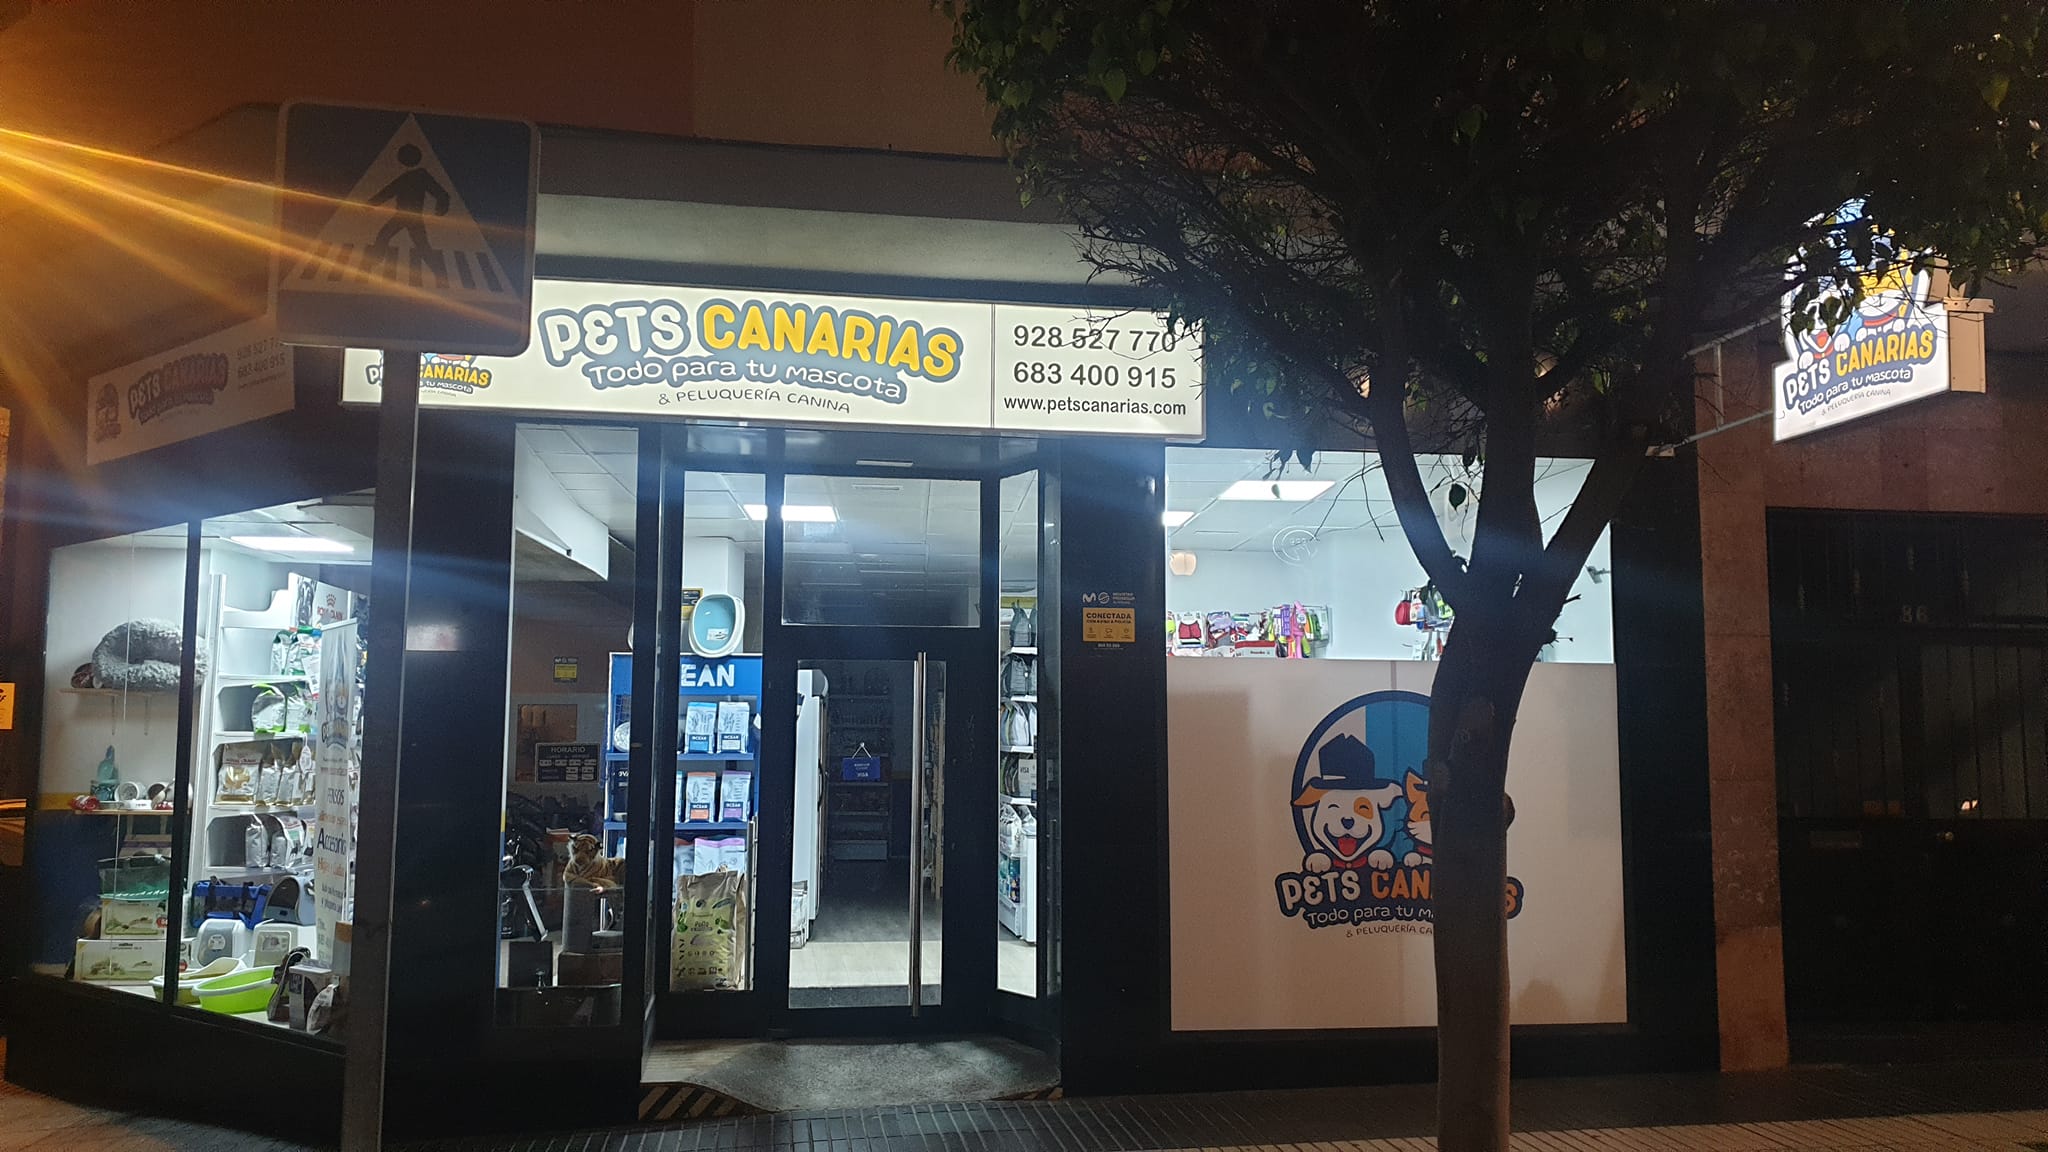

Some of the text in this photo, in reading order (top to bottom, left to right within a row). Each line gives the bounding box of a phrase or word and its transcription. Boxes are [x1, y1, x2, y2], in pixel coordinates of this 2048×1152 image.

[543, 303, 959, 378] PETS CANARIAS
[1013, 324, 1176, 353] 928 527 770
[588, 357, 902, 399] Todo para tu mascota
[1013, 361, 1177, 389] 683 400 915
[1785, 328, 1935, 404] PETS CANARIAS
[437, 381, 473, 394] mascota
[658, 388, 851, 414] & PELUQUERÍA CANINA
[1799, 368, 1912, 413] Todo para tu mascota
[1003, 396, 1187, 416] www.petscanarias.com
[1086, 612, 1132, 620] CONECTADA
[1280, 870, 1361, 911] PETS
[1307, 908, 1349, 924] Todo
[1353, 904, 1391, 922] para
[1396, 903, 1414, 917] tu
